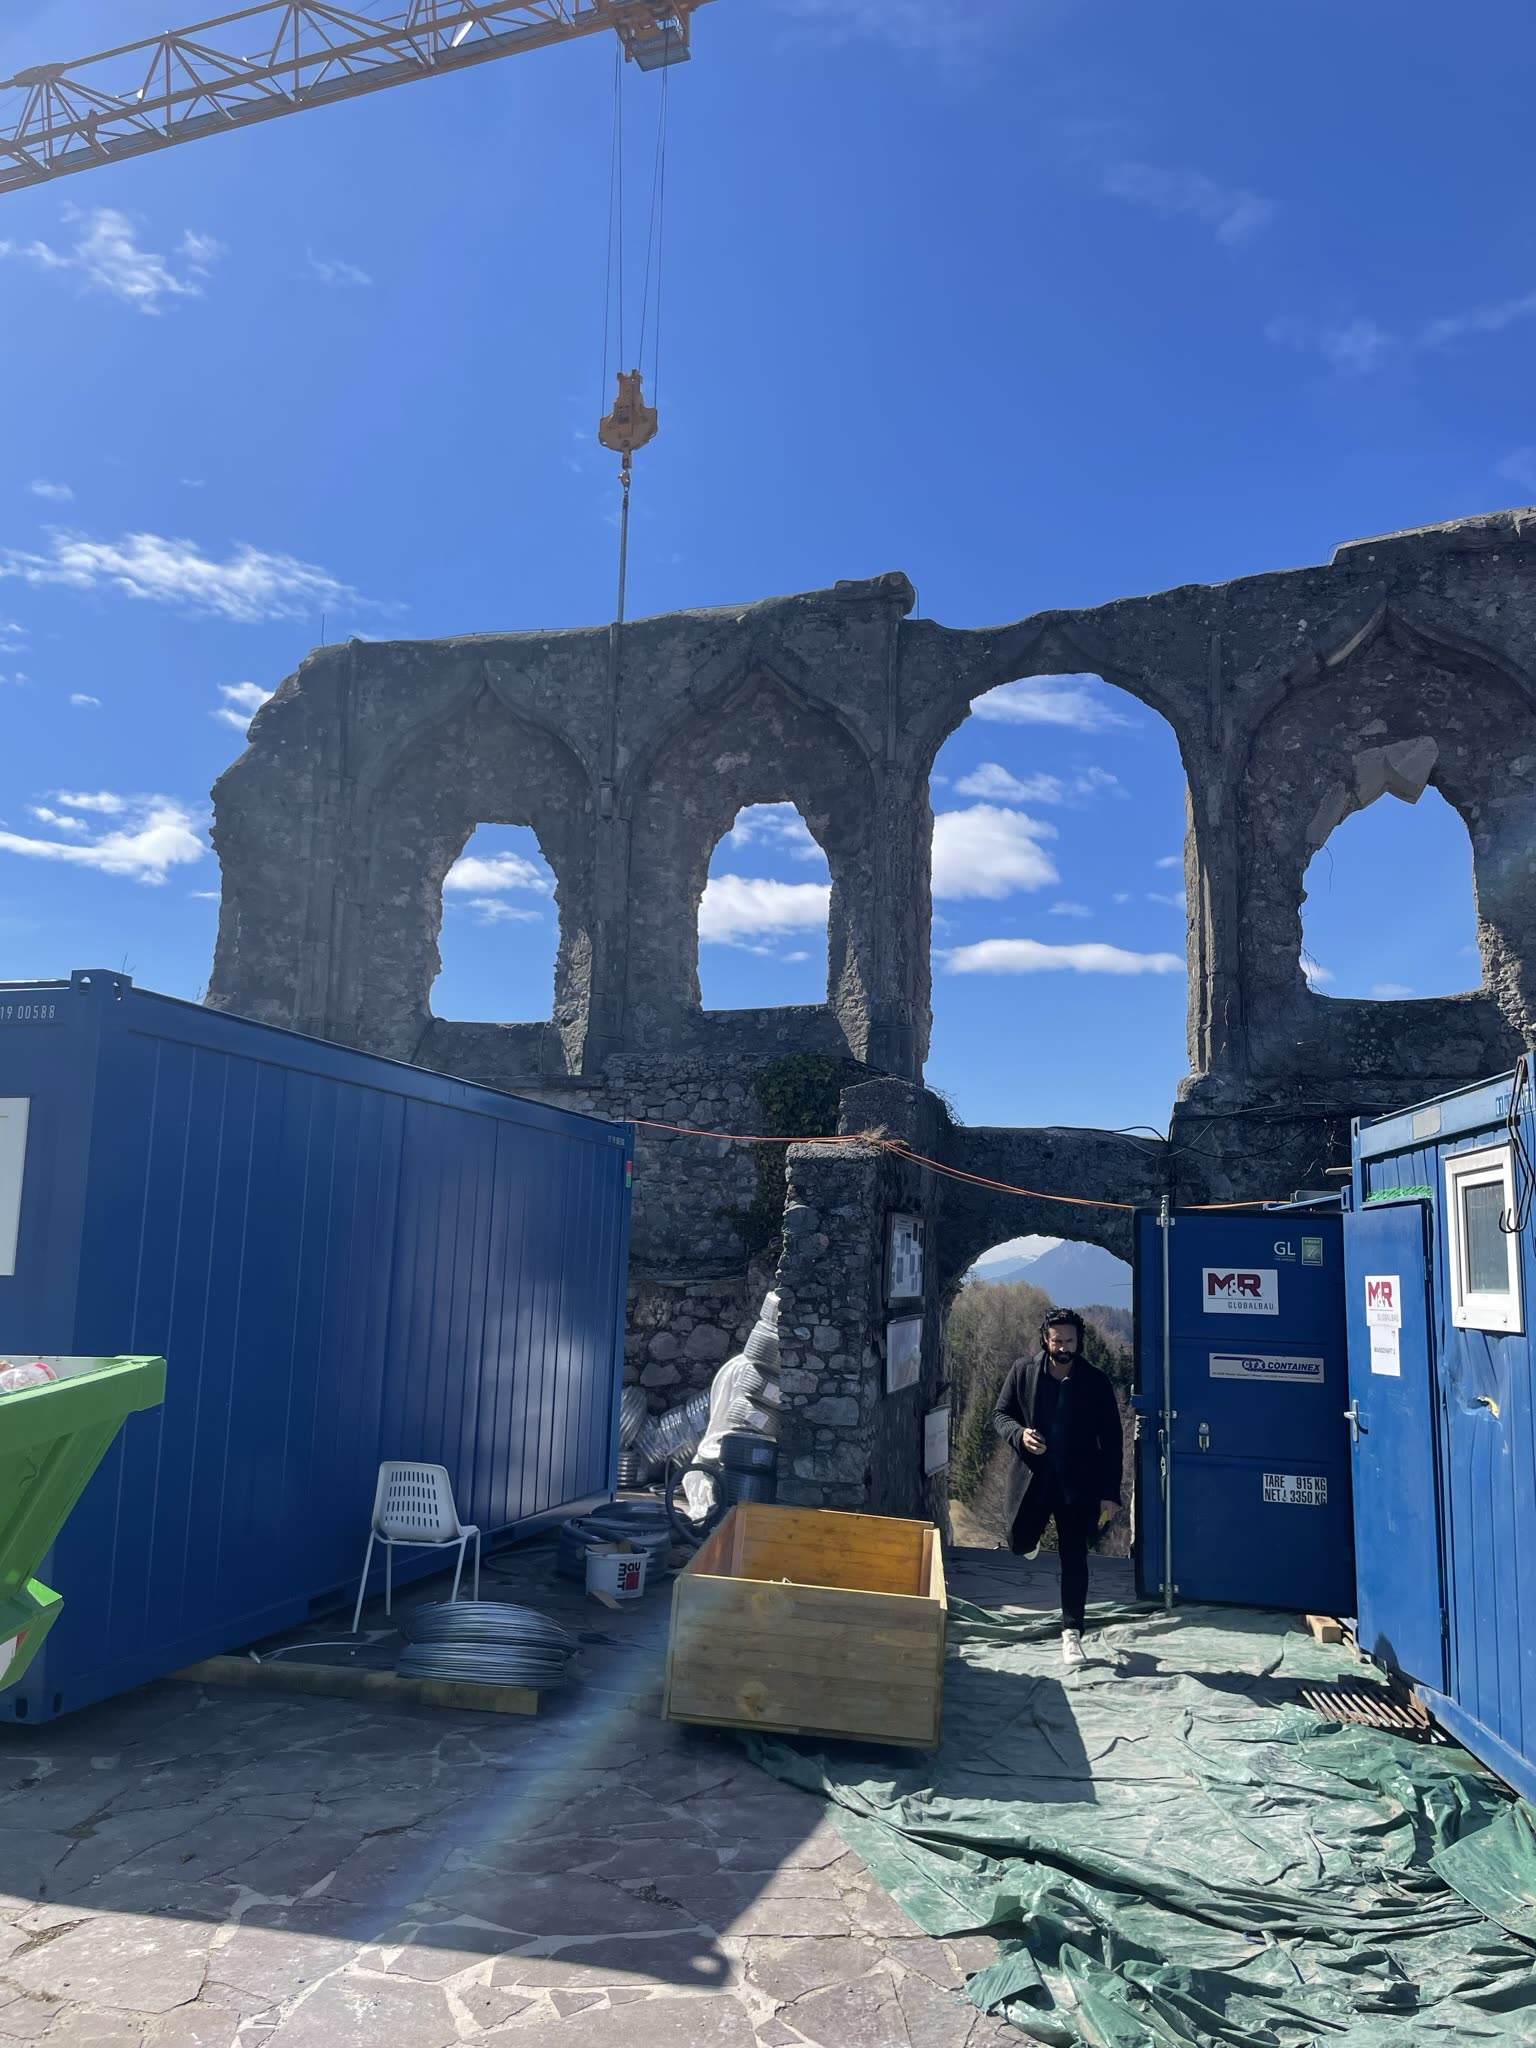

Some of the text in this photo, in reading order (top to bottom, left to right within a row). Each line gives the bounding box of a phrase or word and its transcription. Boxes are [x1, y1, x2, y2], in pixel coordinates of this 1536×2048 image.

[17, 1005, 56, 1019] 00588
[1273, 1241, 1296, 1256] GL
[1208, 1273, 1262, 1297] M&R
[1368, 1281, 1393, 1308] M&R
[1228, 1301, 1275, 1311] GLOBALBAU
[1242, 1359, 1321, 1372] CTX CONTAINEX
[1264, 1475, 1326, 1491] TARE 915 KG
[1290, 1490, 1313, 1503] 3350
[1314, 1491, 1326, 1504] KG
